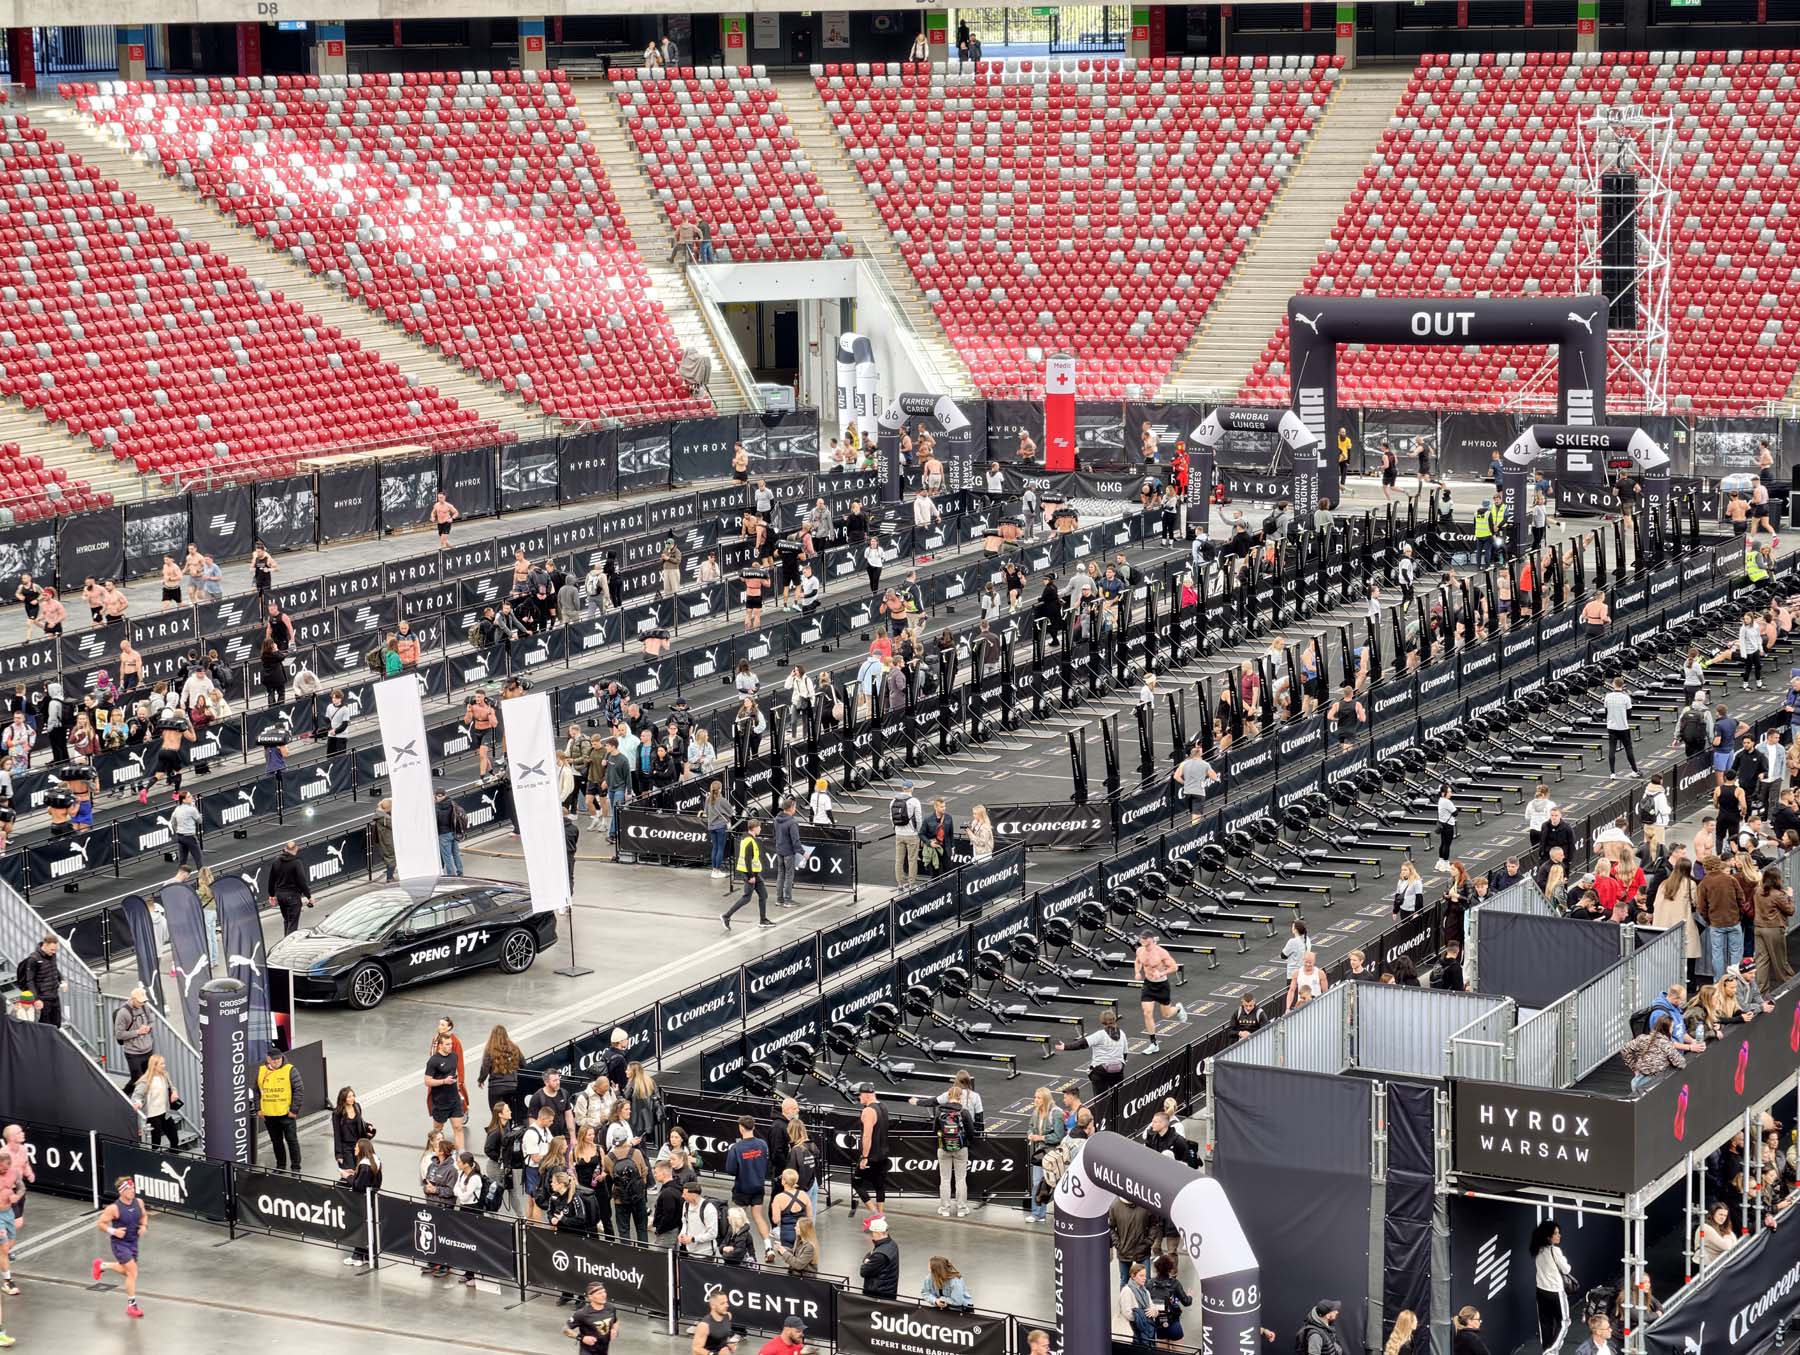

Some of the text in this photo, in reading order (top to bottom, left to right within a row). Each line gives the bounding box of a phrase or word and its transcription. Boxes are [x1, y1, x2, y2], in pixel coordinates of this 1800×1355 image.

[258, 2, 278, 15] D8
[1411, 312, 1475, 336] OUT
[1053, 362, 1071, 370] Medic
[902, 398, 934, 406] FARMERS
[906, 405, 930, 414] CARRY
[1229, 411, 1269, 422] SANDBAG
[1232, 420, 1265, 430] LUNGES
[988, 425, 1024, 433] HYROX
[1200, 425, 1214, 436] 07
[1284, 429, 1298, 441] 07
[683, 442, 727, 454] HYROX
[1461, 439, 1498, 448] #HYROX
[1513, 444, 1529, 455] 01
[1555, 433, 1609, 447] SKIERG
[1634, 448, 1650, 460] 01
[570, 457, 606, 472] HYROX
[455, 477, 481, 488] #HYROX
[818, 477, 876, 493] HYROX
[1022, 478, 1050, 489] 2KG
[1097, 481, 1122, 493] 16KG
[1194, 471, 1202, 505] LUNGES
[1230, 480, 1290, 496] HYROX
[334, 497, 362, 508] #HYROX
[703, 493, 743, 511] HYROX
[837, 494, 877, 511] HYOX
[652, 504, 693, 522] HYROX
[603, 514, 643, 533] HYROX
[554, 525, 594, 545] HYROX
[76, 541, 110, 554] HYROX.COM
[500, 537, 544, 557] HYROX
[629, 541, 661, 560] HYRO
[446, 550, 491, 570] HYROX
[389, 562, 435, 583] HYROX
[329, 576, 378, 597] HYROX
[406, 593, 453, 613] HYROX
[135, 618, 190, 641] HYROX
[0, 650, 52, 675] YROX
[142, 656, 185, 679] HYRO
[1471, 653, 1497, 672] concept 2
[1428, 670, 1455, 690] concept 2
[1384, 689, 1412, 710] concept 2
[1432, 715, 1462, 735] concept 2
[1290, 729, 1320, 750] concept 2
[1385, 736, 1415, 756] concept 2
[1240, 750, 1272, 772] concept 2
[1336, 757, 1368, 780] concept 2
[1288, 780, 1319, 804] concept 2
[1132, 796, 1167, 822] concept 2
[1237, 804, 1269, 829] concept 2
[1021, 818, 1101, 832] concept 2
[650, 829, 708, 843] concept
[1179, 830, 1215, 856] concept 2
[979, 863, 1019, 890] concept 2
[1118, 857, 1156, 884] concept 2
[910, 892, 952, 923] concept 2
[1055, 886, 1094, 913] concept 2
[840, 923, 885, 952] concept 2
[989, 916, 1030, 945] concept 2
[409, 930, 490, 966] XPENG P7+
[1397, 928, 1431, 956] concept 2
[765, 955, 811, 986] concept 2
[921, 949, 963, 978] concept 2
[682, 991, 734, 1023] concept 2
[845, 984, 891, 1016] concept 2
[219, 1007, 240, 1016] POINT
[766, 1022, 815, 1053] concept 2
[231, 1030, 248, 1164] CROSSING POINT
[1137, 1075, 1180, 1110] concept 2
[1480, 1104, 1590, 1137] HYROX
[1480, 1135, 1590, 1163] WARSAW
[906, 1158, 994, 1174] conept
[1092, 1162, 1162, 1209] WALL BALLS
[257, 1194, 346, 1230] amazfit
[438, 1235, 477, 1252] Warszawa
[574, 1255, 644, 1290] Therabody
[1056, 1248, 1064, 1317] BALLS
[729, 1288, 818, 1319] CENTR
[1231, 1285, 1257, 1307] 08
[870, 1338, 924, 1354] EXPERT KREM
